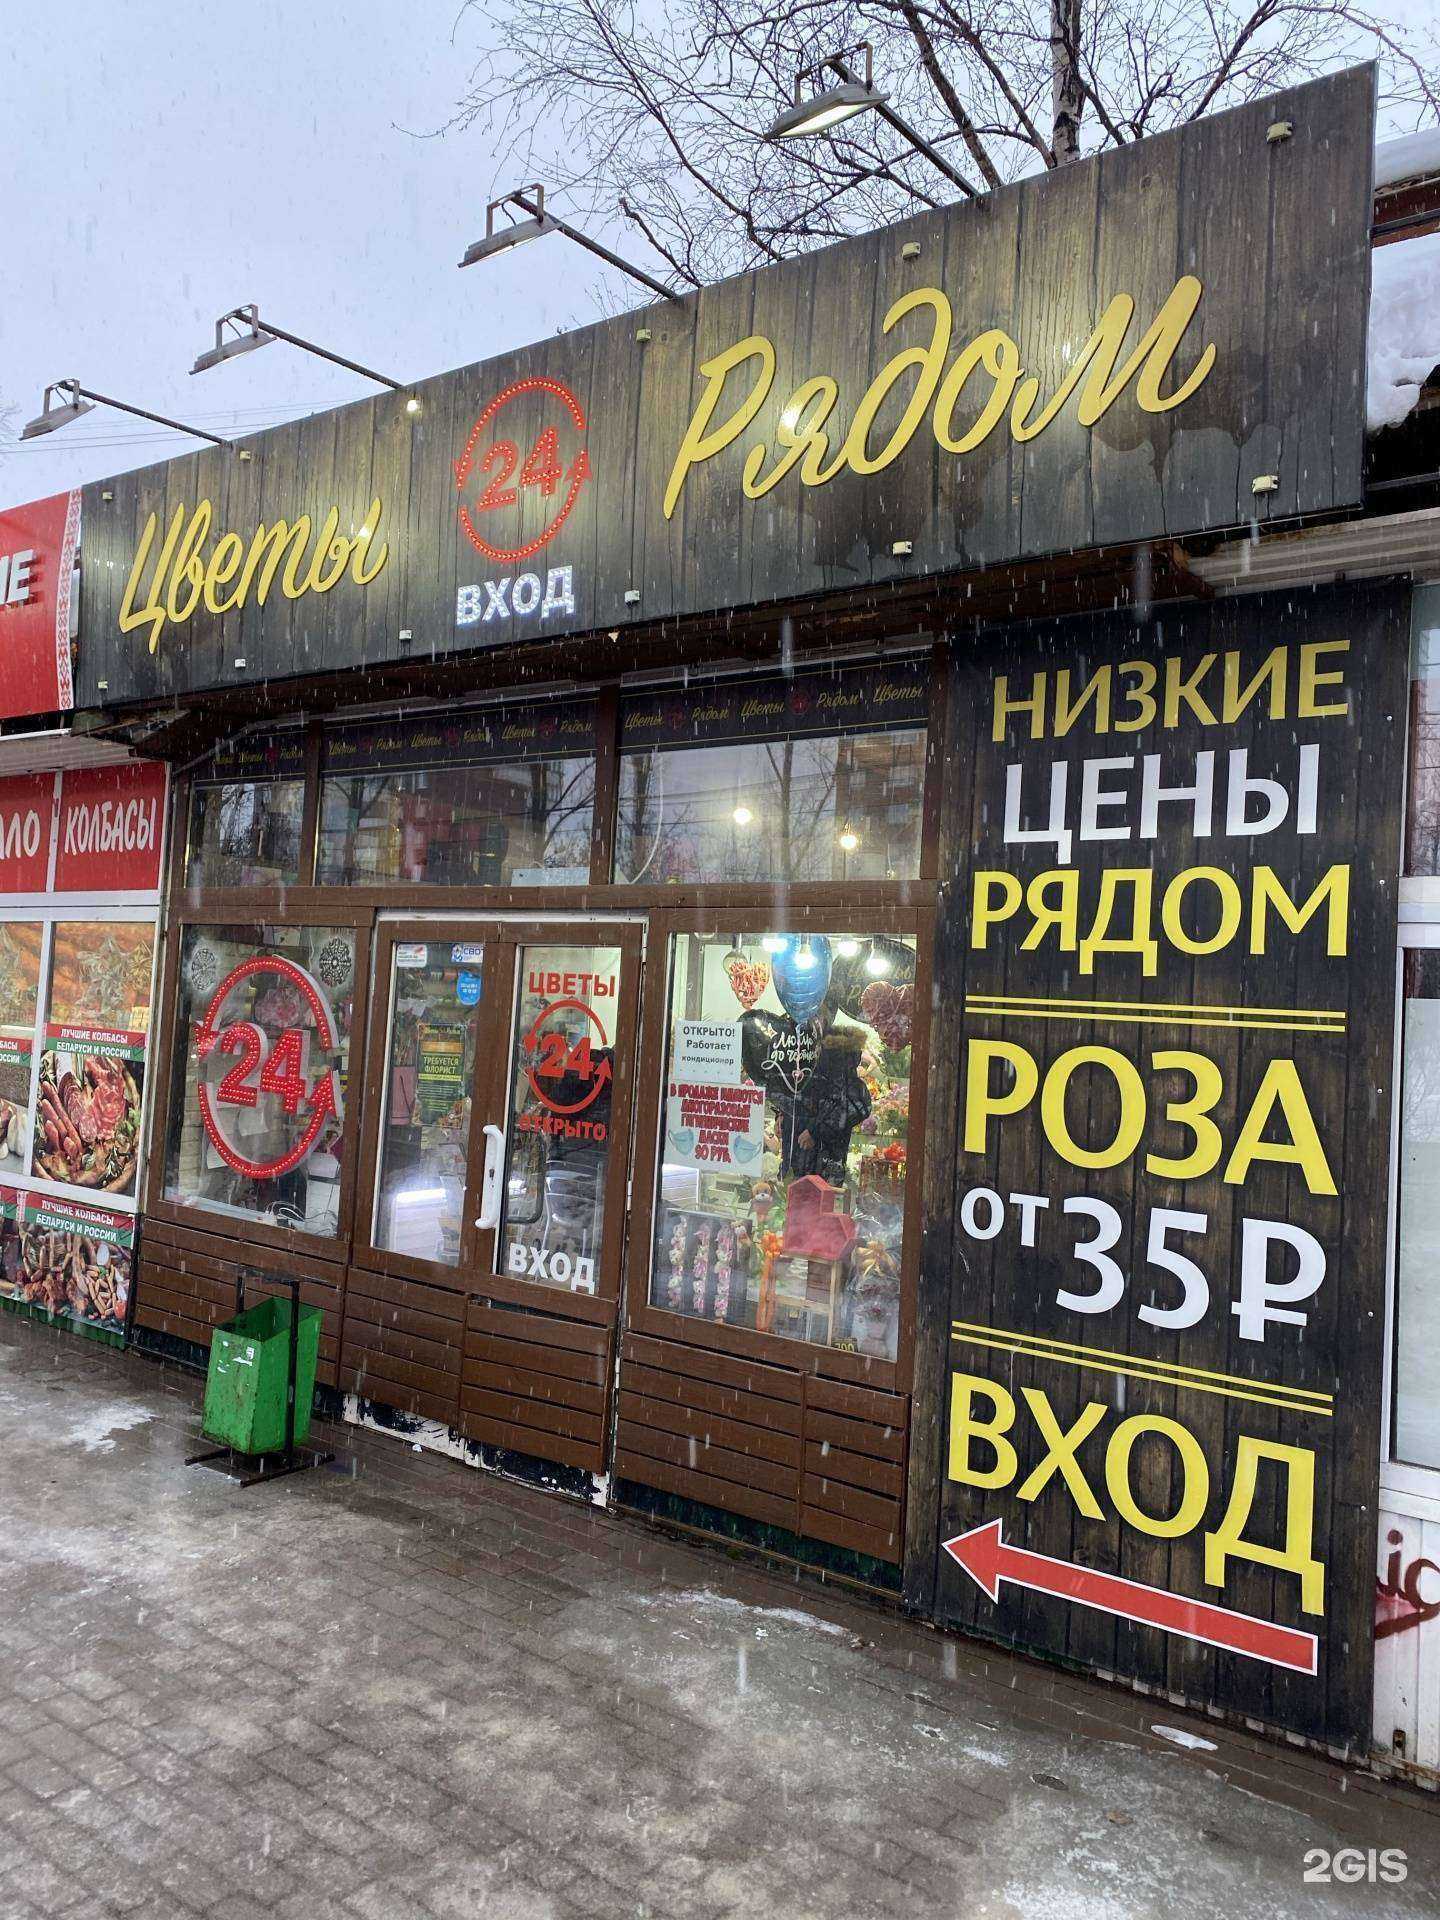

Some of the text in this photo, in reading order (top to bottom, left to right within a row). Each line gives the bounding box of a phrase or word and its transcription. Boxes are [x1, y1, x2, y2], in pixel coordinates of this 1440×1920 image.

[662, 275, 1217, 520] Рядом
[476, 425, 563, 513] 24
[118, 497, 388, 655] Цветы
[456, 565, 576, 626] ВХОД
[873, 682, 925, 704] Цветы
[991, 639, 1351, 742] НИЗКИЕ
[64, 797, 157, 856] КОЛБАСЫ
[1003, 743, 1321, 865] ЦЕНЫ
[970, 864, 1351, 977] РЯДОМ
[528, 971, 616, 998] ЦВЕТЫ
[56, 1041, 131, 1059] БЕЛАРУСИ И РОССИИ
[60, 1028, 128, 1044] ЛУЧШИЕ КОЛБАСЫ
[540, 1033, 595, 1081] 24
[683, 1026, 735, 1038] ОТКРЫТО!
[686, 1040, 732, 1051] Работает
[216, 1020, 309, 1116] 24
[424, 1056, 460, 1067] ТРЕБУЕТСЯ
[519, 1113, 607, 1141] ОТКРЫТО
[963, 1038, 1339, 1196] РОЗА
[36, 1213, 117, 1242] БЕЛАРУСИ И РОССИИ
[41, 1199, 115, 1226] ЛУЧШИЕ КОЛБАСЫ
[508, 1242, 596, 1296] ВХОД
[947, 1371, 1326, 1617] ВХОД
